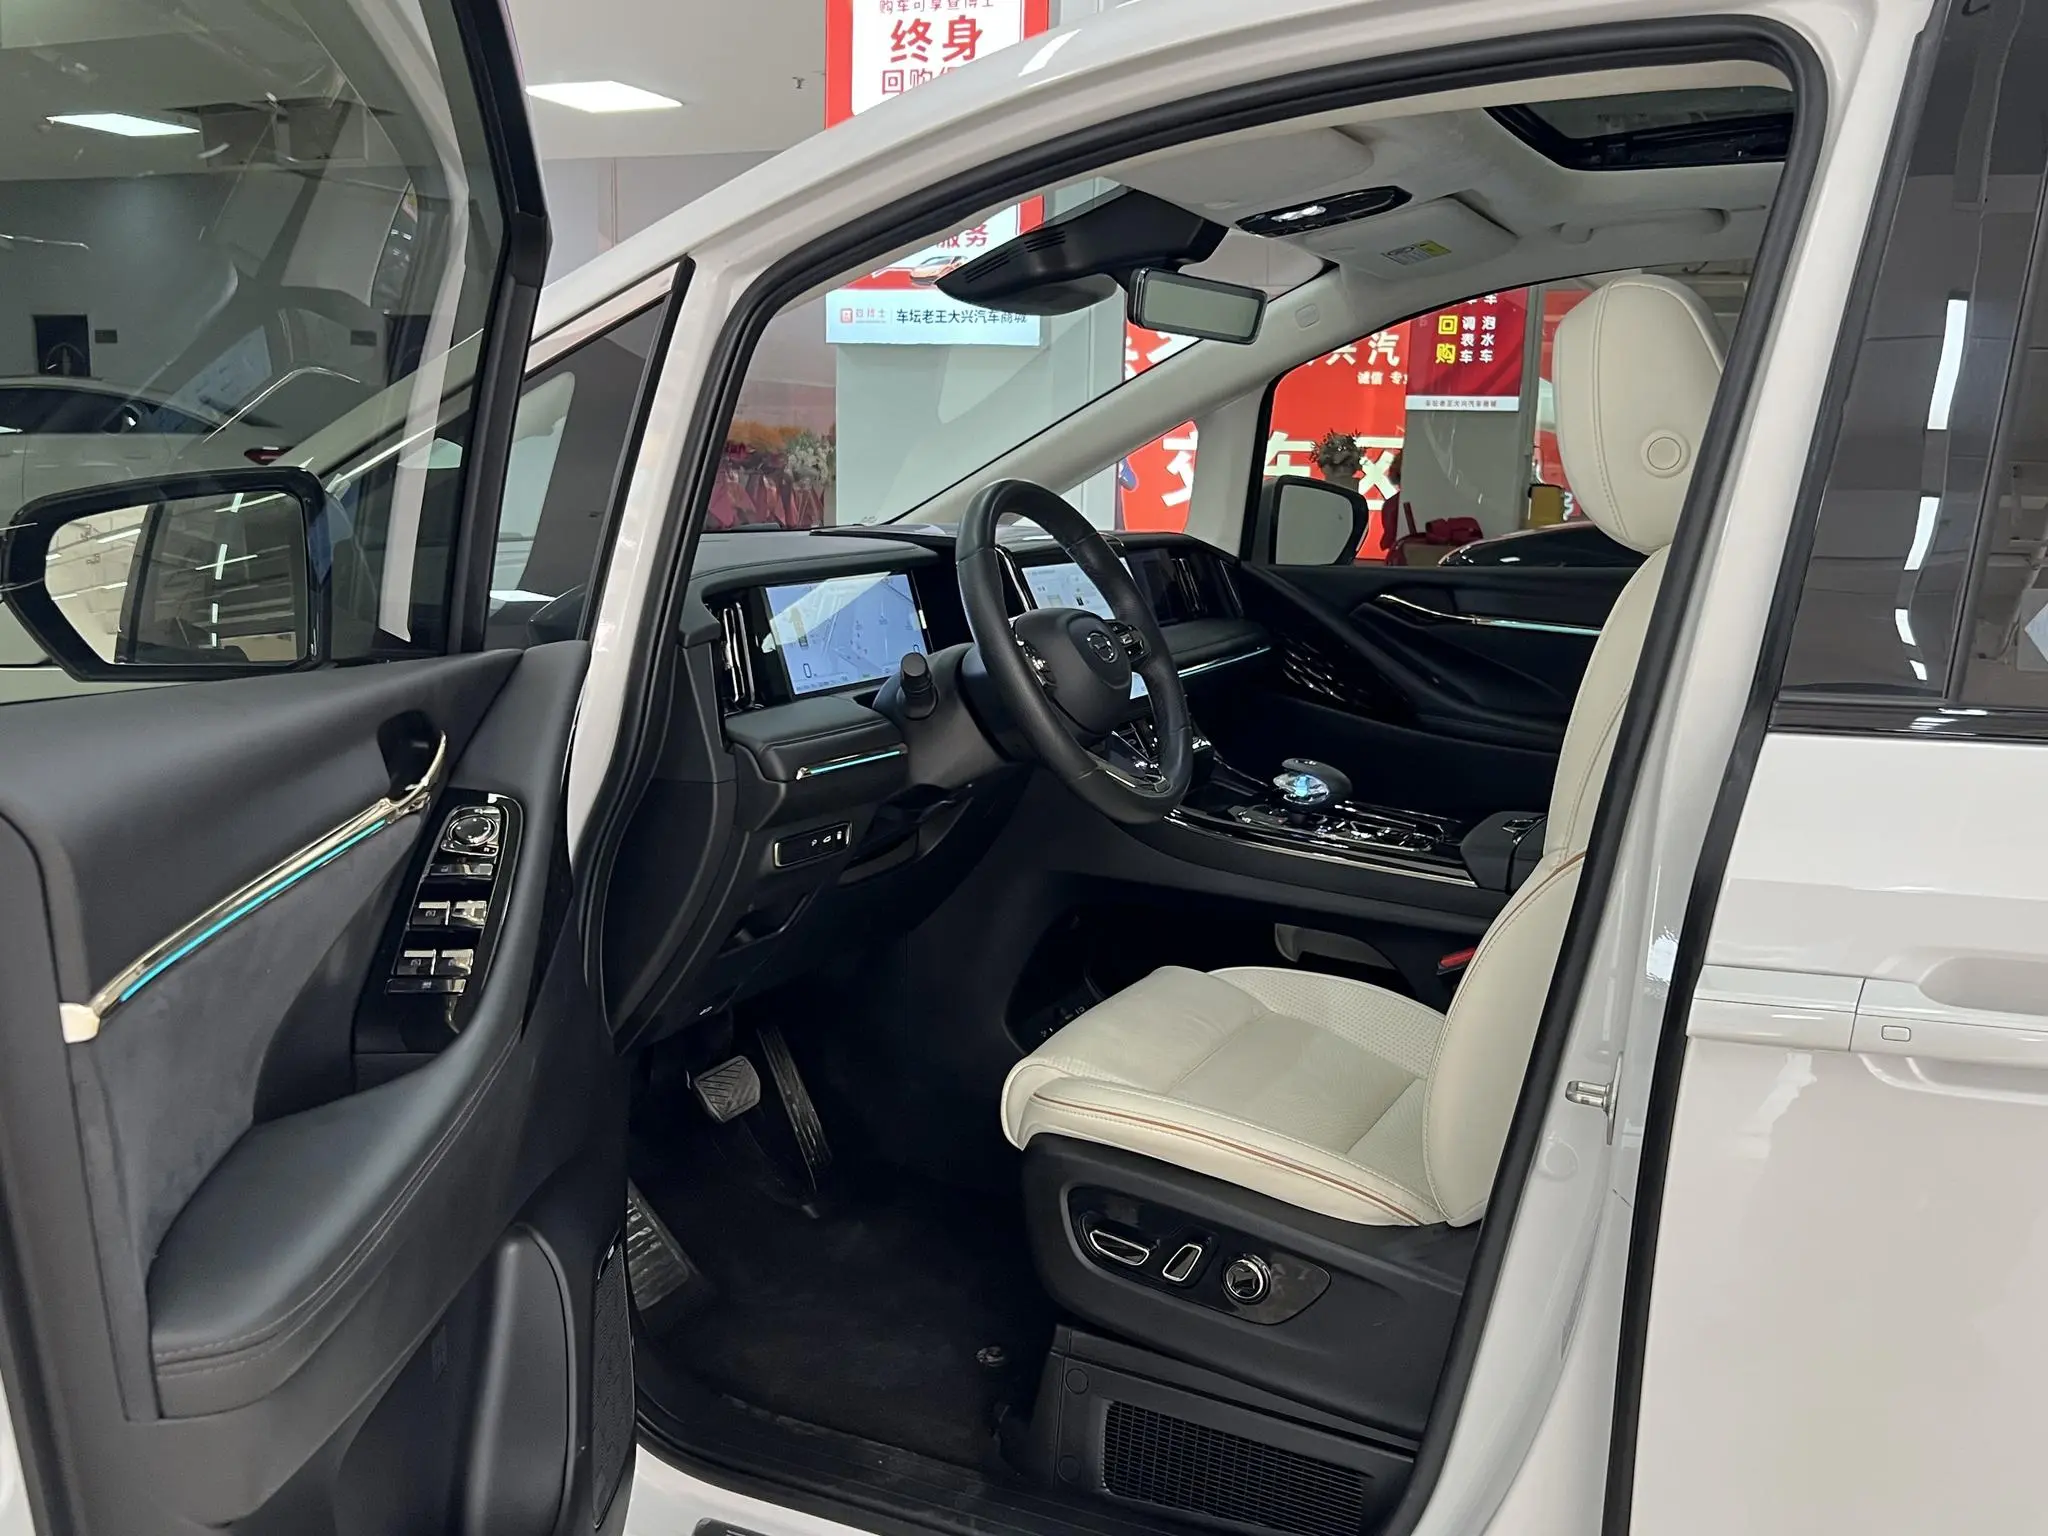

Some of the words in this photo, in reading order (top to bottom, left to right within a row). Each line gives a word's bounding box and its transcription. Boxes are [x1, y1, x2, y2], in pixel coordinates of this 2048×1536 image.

[890, 15, 983, 62] 终身
[882, 66, 958, 95] 回购
[1436, 315, 1458, 364] 回购
[1479, 315, 1496, 363] 泡水车
